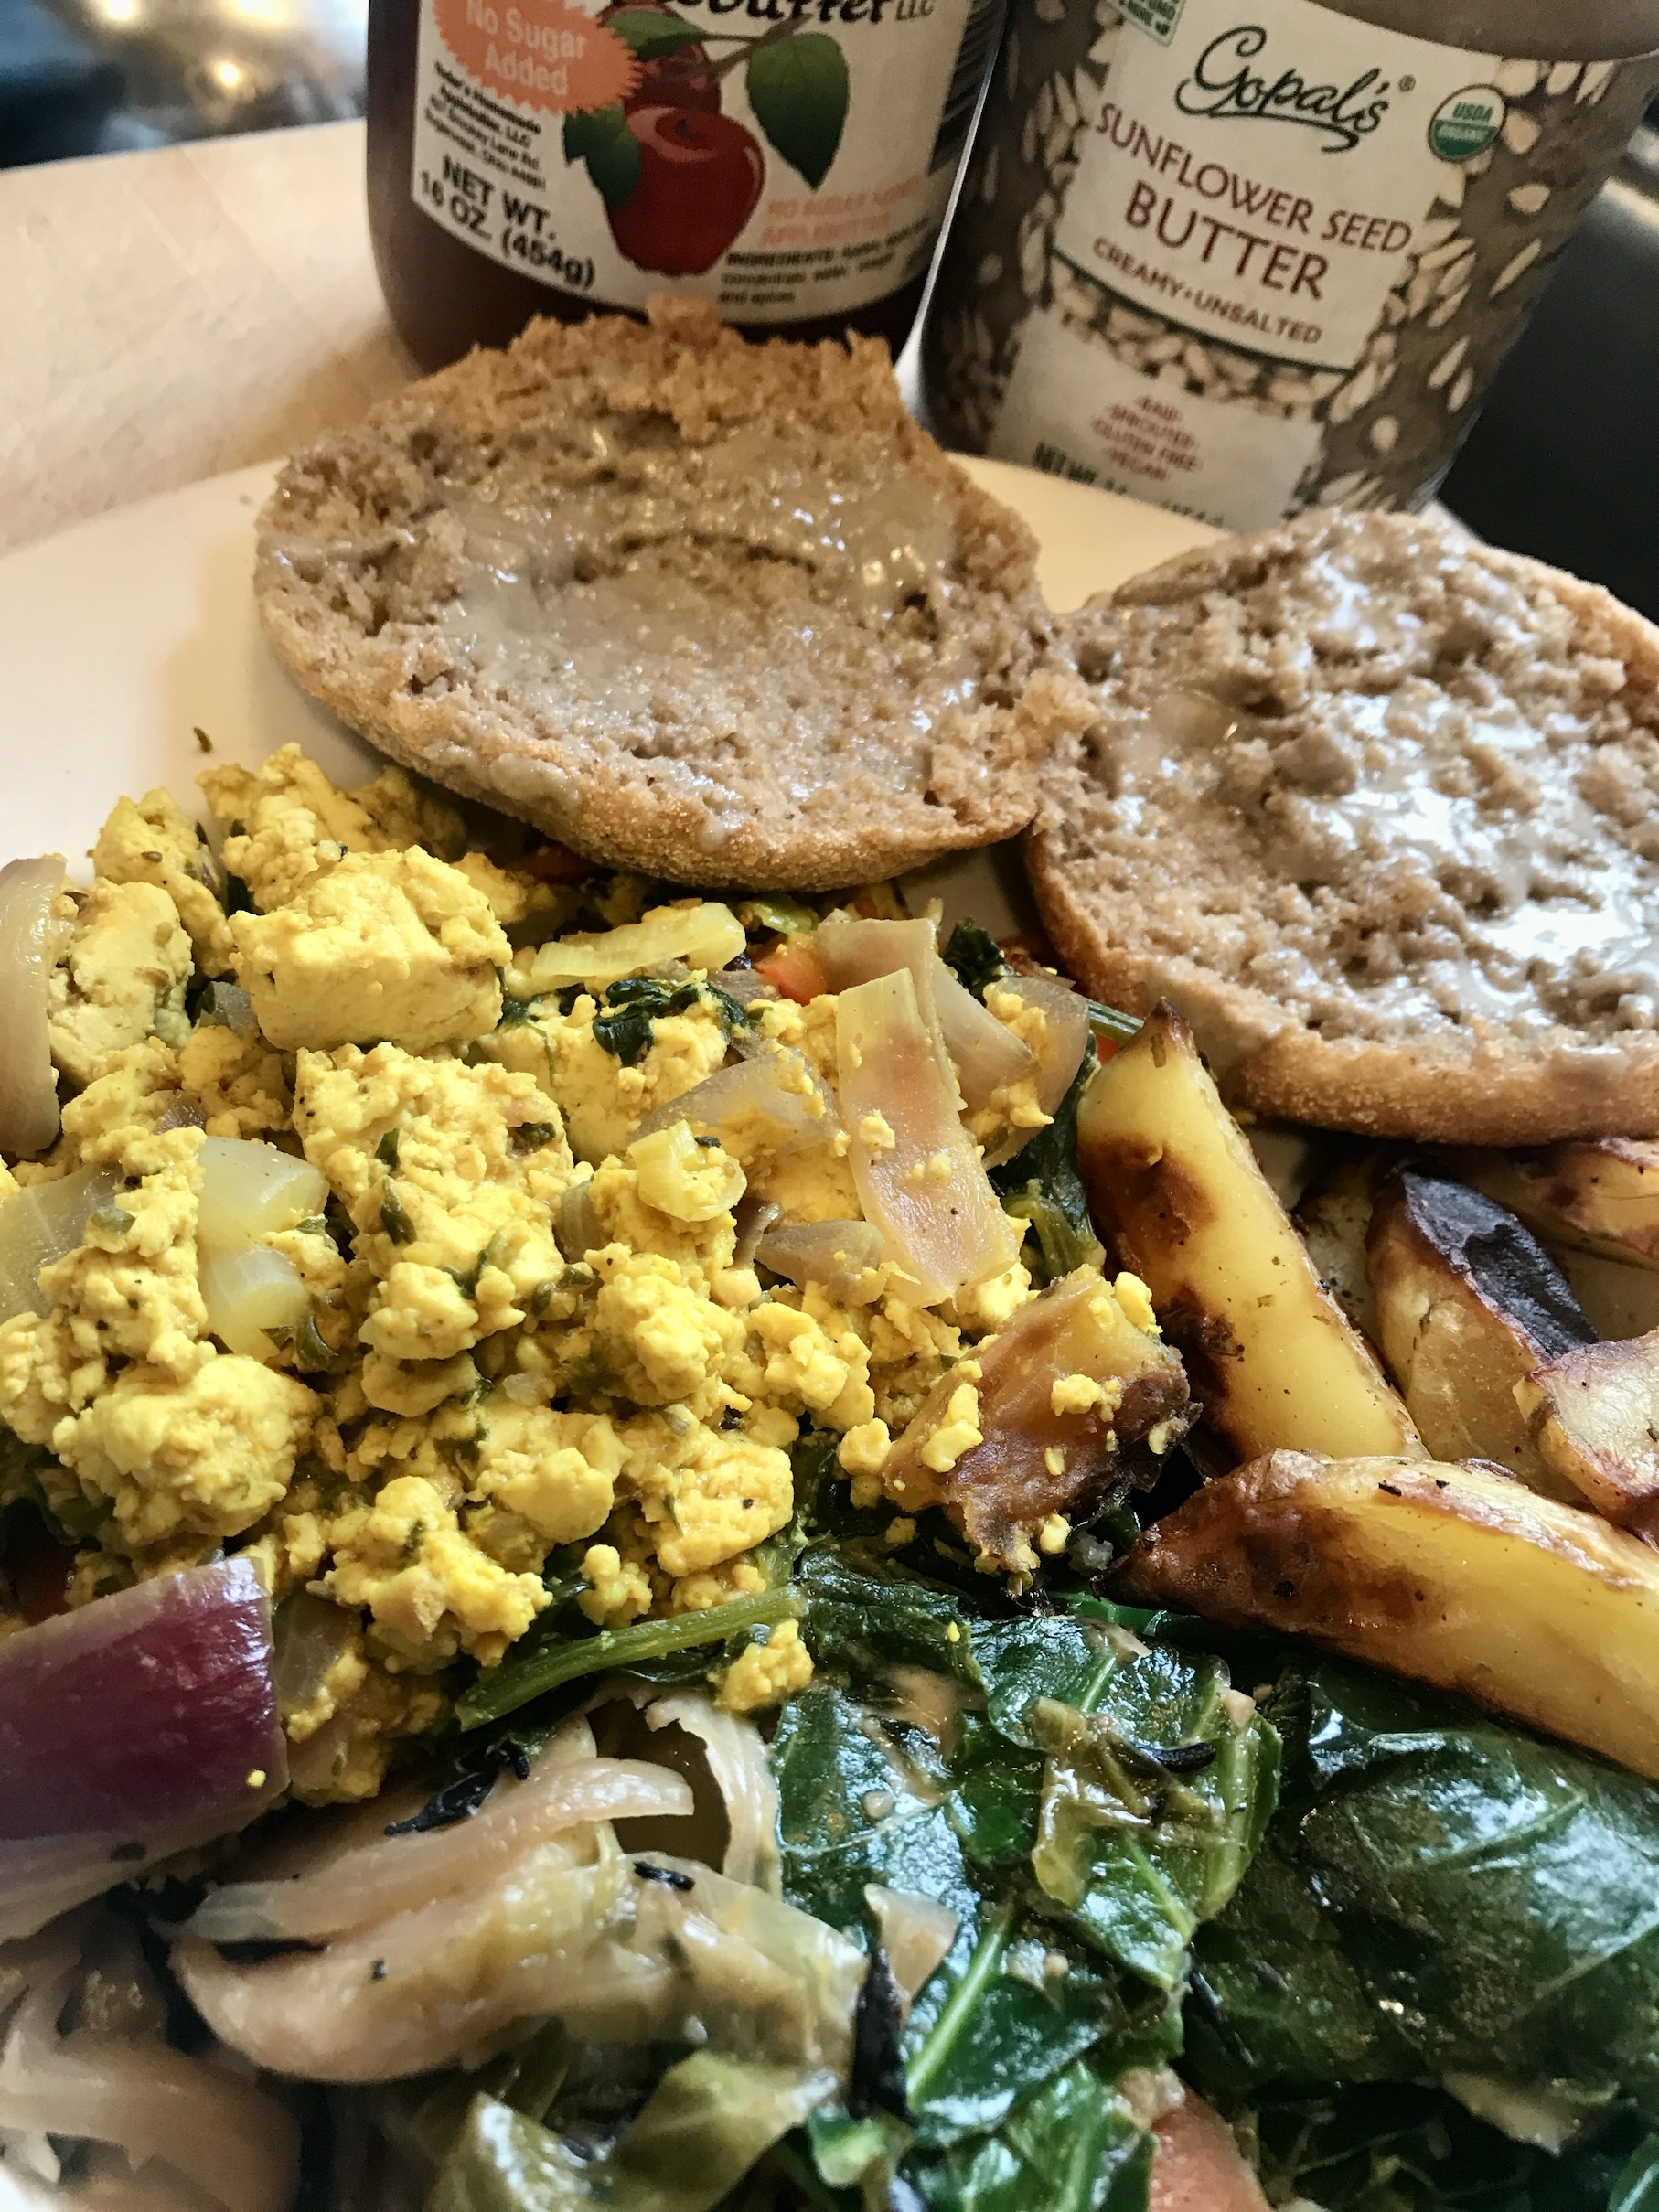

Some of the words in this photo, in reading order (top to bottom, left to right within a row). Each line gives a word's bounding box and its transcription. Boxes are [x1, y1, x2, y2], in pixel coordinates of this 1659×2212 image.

[466, 0, 498, 35] No
[506, 7, 586, 63] Sugar
[485, 43, 568, 97] Added
[1175, 26, 1389, 153] Gopal's
[1452, 101, 1493, 123] USDA
[442, 153, 496, 208] NET
[502, 189, 556, 241] WT.
[1097, 102, 1314, 233] SUNFLOWER
[1322, 209, 1413, 253] SEED
[500, 226, 596, 291] (454g)
[1125, 180, 1330, 301] BUTTER
